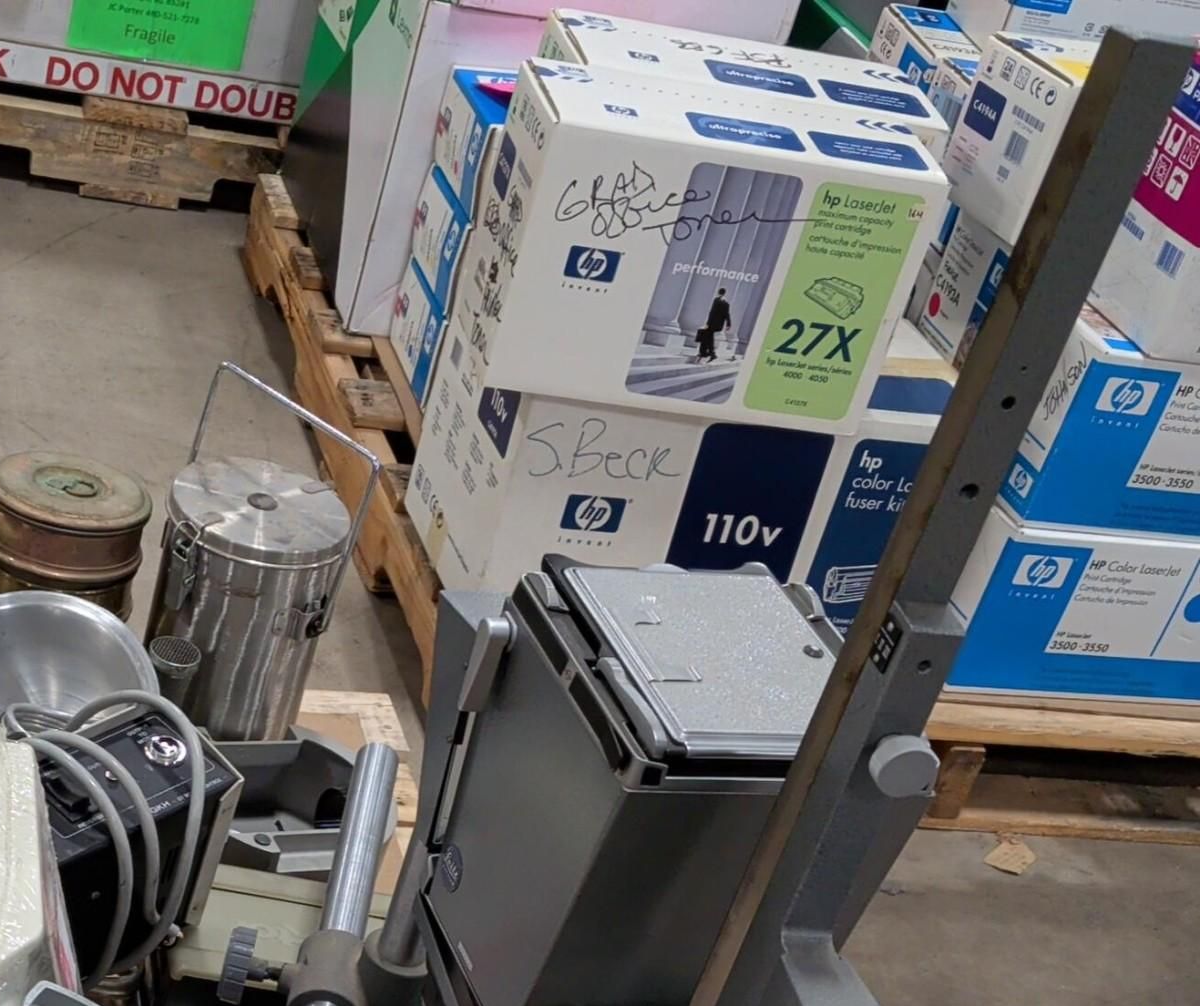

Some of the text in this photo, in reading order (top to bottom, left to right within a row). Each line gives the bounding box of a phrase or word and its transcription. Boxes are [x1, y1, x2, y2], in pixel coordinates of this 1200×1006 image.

[123, 24, 176, 45] Fragile
[45, 56, 100, 91] DO
[109, 67, 187, 104] NOT
[194, 80, 298, 121] DOUB
[822, 190, 897, 215] hp LaserJet
[813, 218, 872, 236] print cartridge
[818, 209, 895, 229] maximum capacity
[672, 261, 760, 284] performance
[561, 282, 609, 294] invent
[774, 318, 863, 363] 27X
[808, 373, 829, 384] 4050
[1176, 385, 1194, 398] HP
[859, 449, 883, 474] hp
[852, 472, 894, 491] color
[1131, 474, 1195, 489] 3500 3550
[845, 491, 885, 510] fuser
[702, 512, 784, 548] 110v
[557, 535, 614, 548] invent
[1088, 559, 1182, 577] HP Color LaserJet
[1049, 640, 1110, 653] 3500 3550
